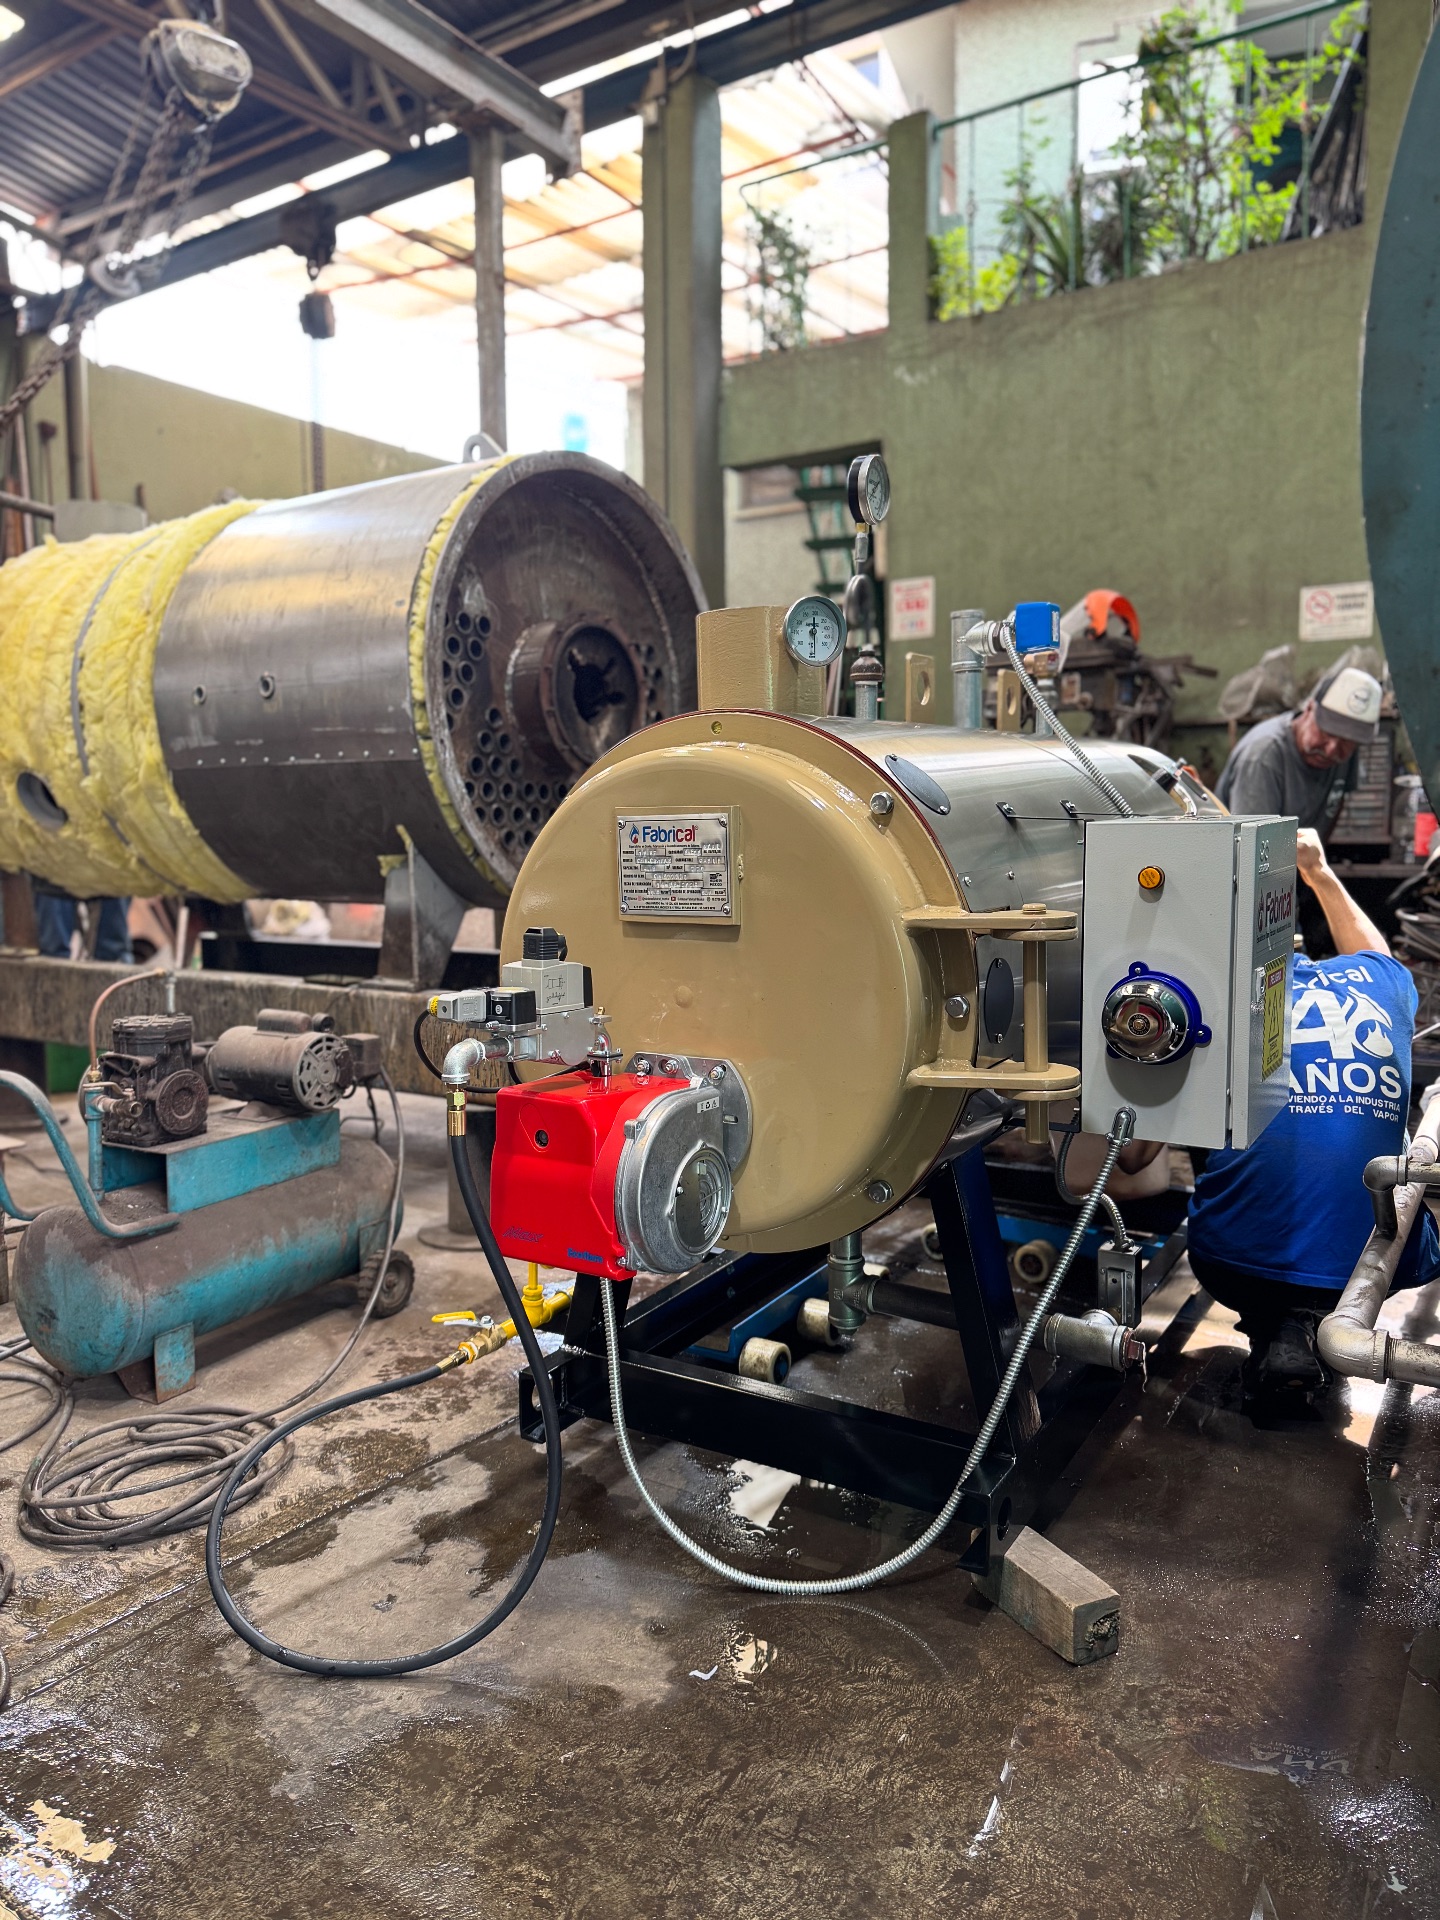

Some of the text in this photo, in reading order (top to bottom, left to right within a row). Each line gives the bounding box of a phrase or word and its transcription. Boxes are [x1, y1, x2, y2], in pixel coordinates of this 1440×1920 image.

[642, 824, 696, 843] Fabrical
[1288, 1103, 1399, 1123] TRAVÉS DEL VAPOR
[1328, 1094, 1337, 1103] A
[1338, 1094, 1354, 1103] LA
[1355, 1095, 1401, 1113] INDUSTRIA
